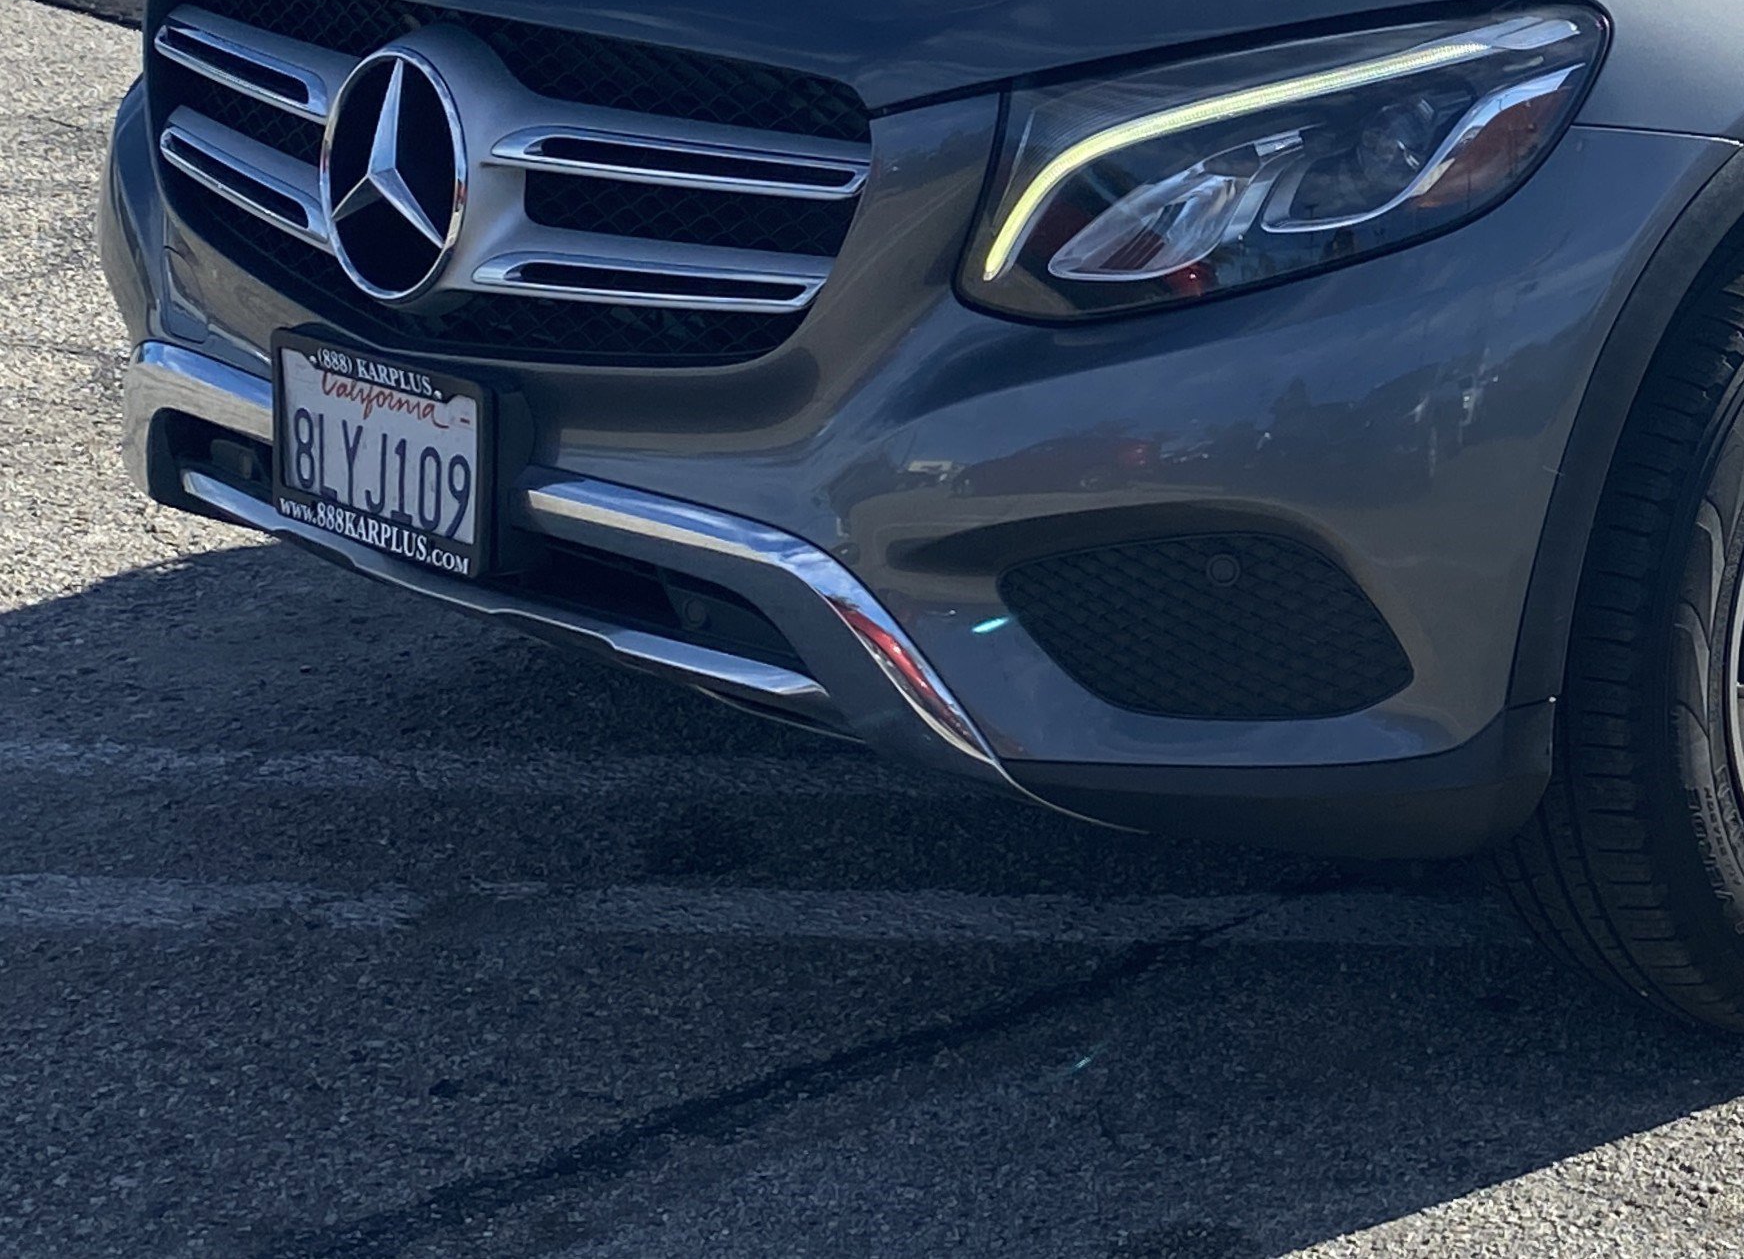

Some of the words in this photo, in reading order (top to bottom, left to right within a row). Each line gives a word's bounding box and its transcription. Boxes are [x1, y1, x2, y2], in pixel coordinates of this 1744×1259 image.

[317, 347, 352, 374] (888)
[356, 357, 433, 396] KARPLUS
[321, 370, 449, 429] California
[293, 407, 472, 538] 8LYJ109
